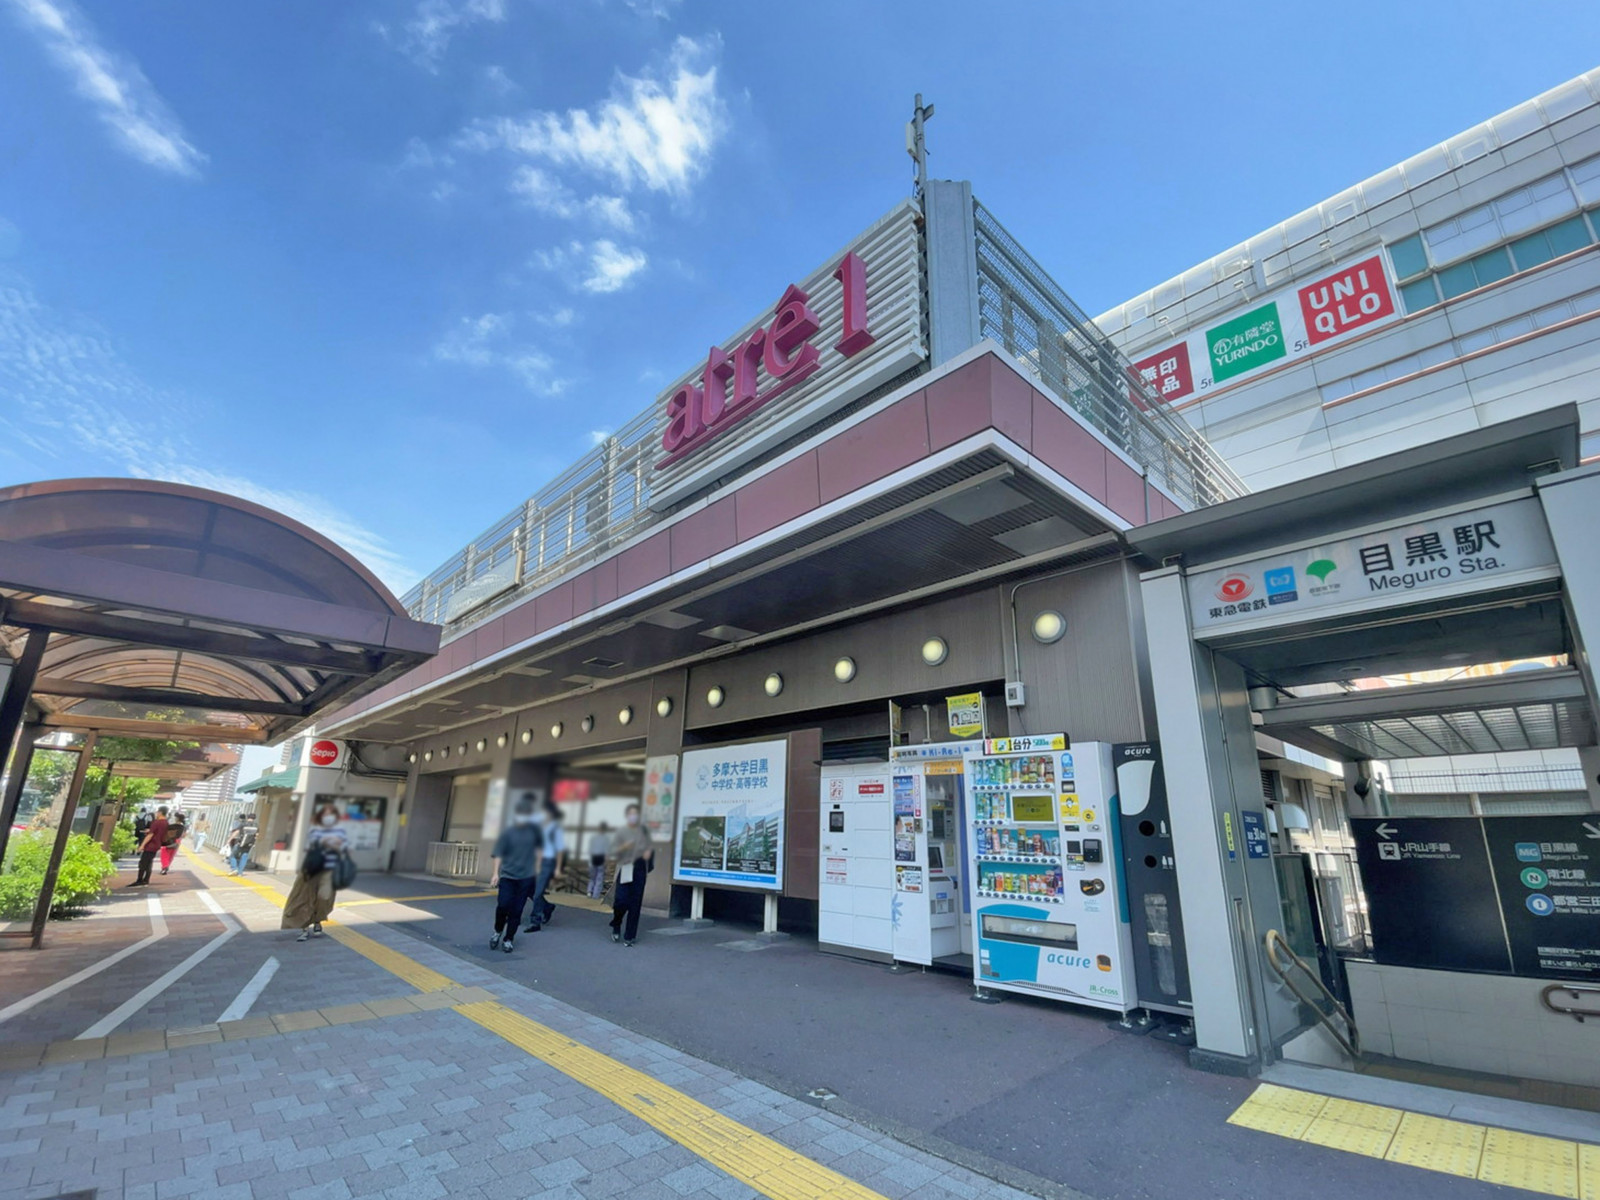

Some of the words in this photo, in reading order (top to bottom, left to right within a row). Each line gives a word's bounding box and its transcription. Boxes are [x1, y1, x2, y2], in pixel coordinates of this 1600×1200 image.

[1308, 269, 1370, 310] UNI
[832, 250, 877, 359] 1
[1314, 292, 1382, 334] QLO
[1231, 320, 1276, 347] 有隣堂
[1214, 334, 1279, 367] YURINDO
[1293, 340, 1309, 353] 5F
[1200, 377, 1214, 390] 5F
[1359, 520, 1501, 576] 目黒駅
[1369, 565, 1452, 592] Meguro
[1459, 556, 1506, 575] Sta.
[1208, 598, 1268, 619] 東急電鉄
[1124, 747, 1152, 756] acure
[712, 758, 769, 778] 多摩大学目黒
[1400, 842, 1452, 853] JR山手線
[1518, 848, 1539, 857] MG
[1529, 874, 1539, 882] N
[1047, 953, 1092, 969] acure
